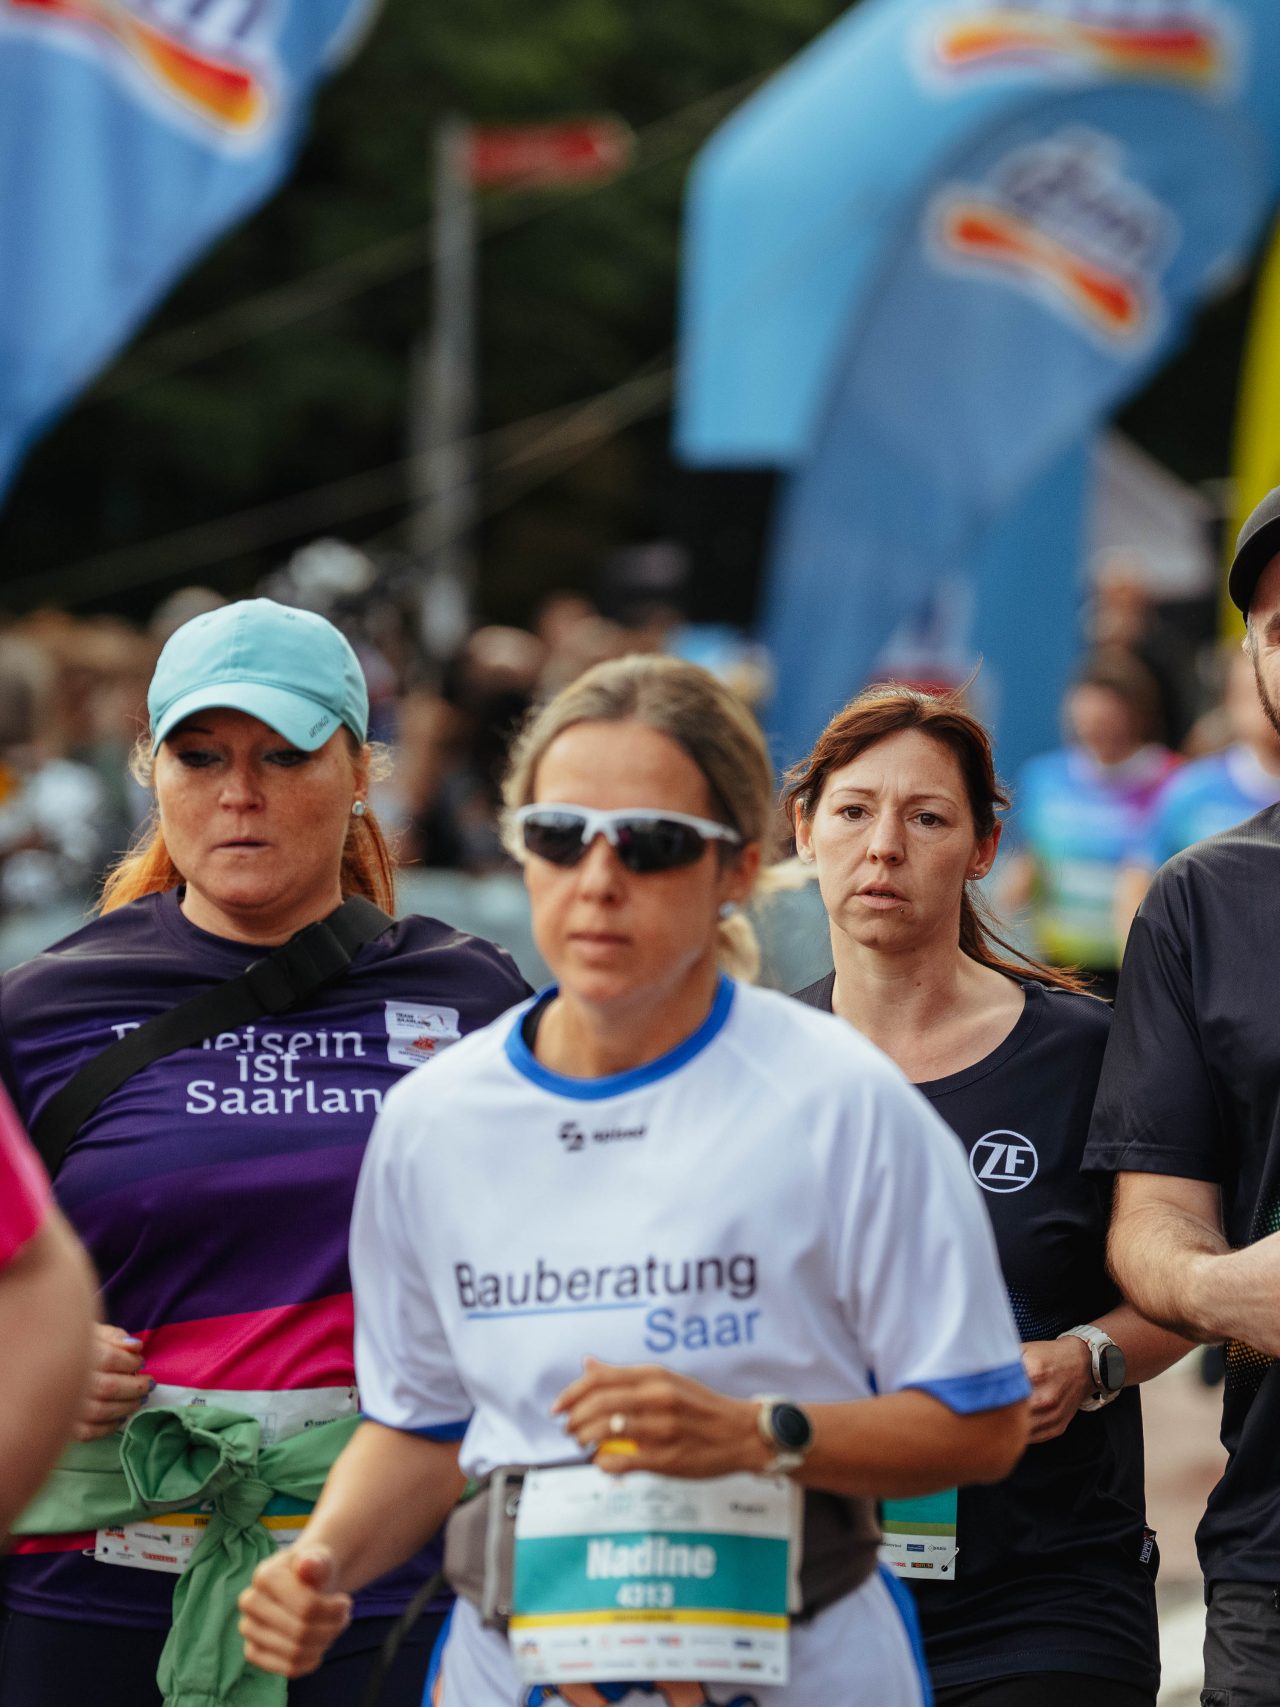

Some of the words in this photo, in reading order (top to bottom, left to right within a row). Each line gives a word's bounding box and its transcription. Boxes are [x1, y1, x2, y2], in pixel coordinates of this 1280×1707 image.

[236, 1049, 301, 1083] ist
[974, 1136, 1036, 1186] ZF
[454, 1253, 757, 1309] Bauberatung
[645, 1306, 761, 1353] Saar
[586, 1537, 717, 1581] Nadine
